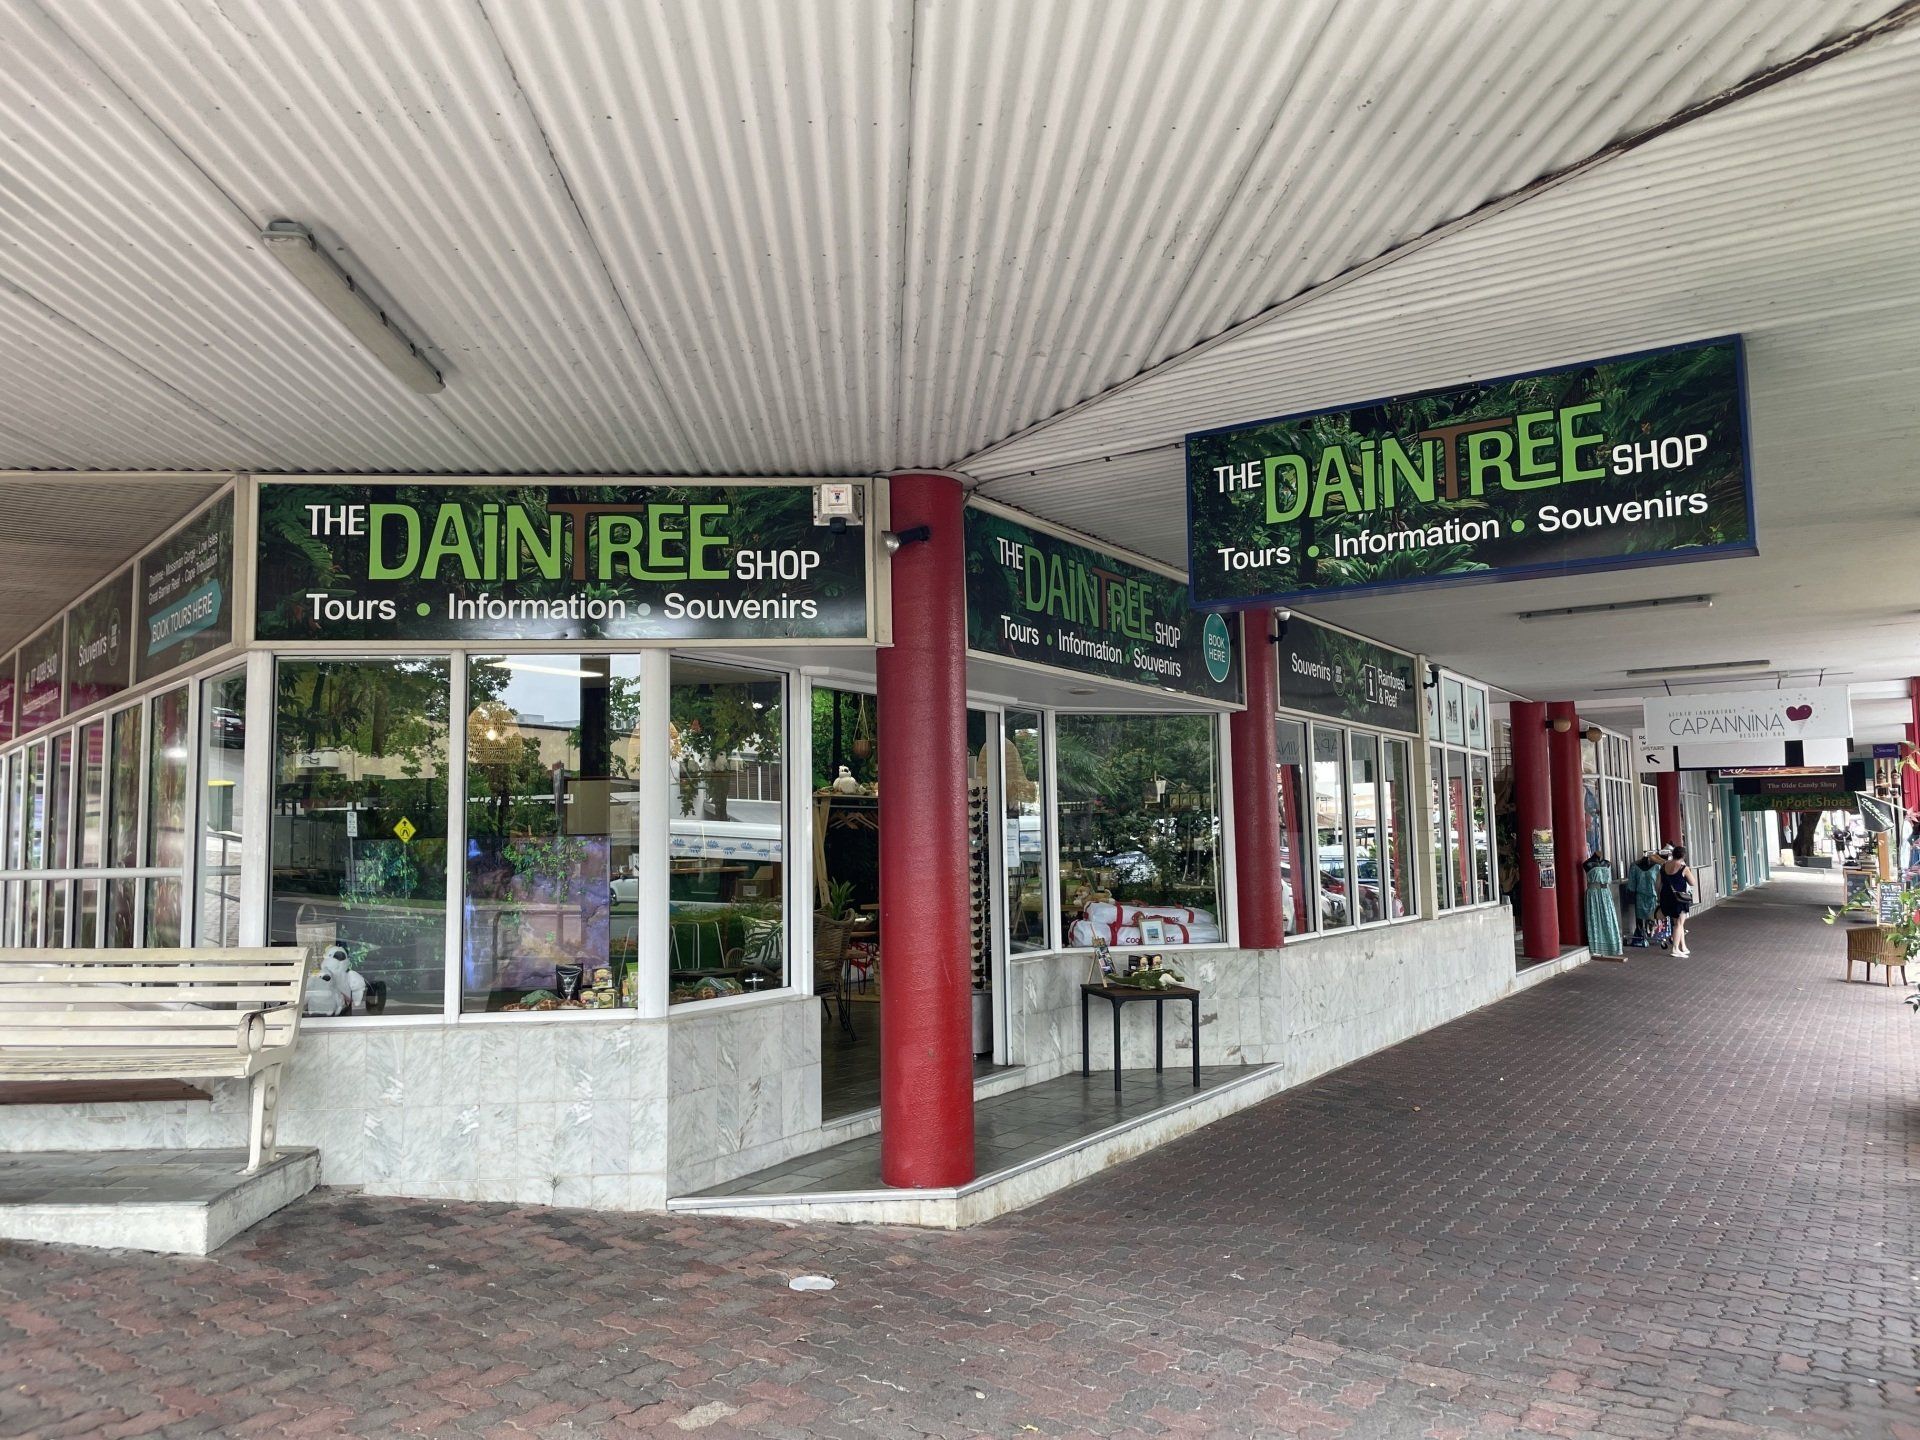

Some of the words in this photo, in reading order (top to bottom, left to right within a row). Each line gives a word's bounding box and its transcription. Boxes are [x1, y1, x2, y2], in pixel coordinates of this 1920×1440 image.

[1213, 460, 1261, 493] THE
[1612, 434, 1708, 476] SHOP
[305, 505, 365, 536] THE
[736, 550, 820, 580] SHOP
[1218, 546, 1291, 571] Tours
[1334, 517, 1500, 558] Information
[1538, 490, 1709, 532] Souvenirs
[306, 593, 397, 620] Tours
[448, 592, 626, 620] Information
[664, 592, 818, 620] Souvenirs
[997, 536, 1024, 570] THE
[1155, 621, 1181, 649] SHOP
[152, 619, 170, 643] BOOK
[170, 605, 192, 632] TOURS
[192, 592, 213, 619] HERE
[79, 634, 107, 667] Souvenirs
[1001, 614, 1040, 646] Tours
[1058, 628, 1123, 664] Information
[1133, 650, 1182, 678] Souvenirs
[1208, 633, 1225, 649] BOOK
[1208, 649, 1226, 662] HERE
[1291, 652, 1331, 682] Souvenirs
[1377, 668, 1406, 692] Rainforest
[1378, 688, 1384, 705] &
[1384, 690, 1398, 708] Reef
[1668, 713, 1785, 736] CAPANNINA
[1820, 781, 1837, 790] Shop
[1771, 798, 1783, 808] In
[1786, 798, 1814, 808] Port
[1815, 796, 1852, 808] Shoes
